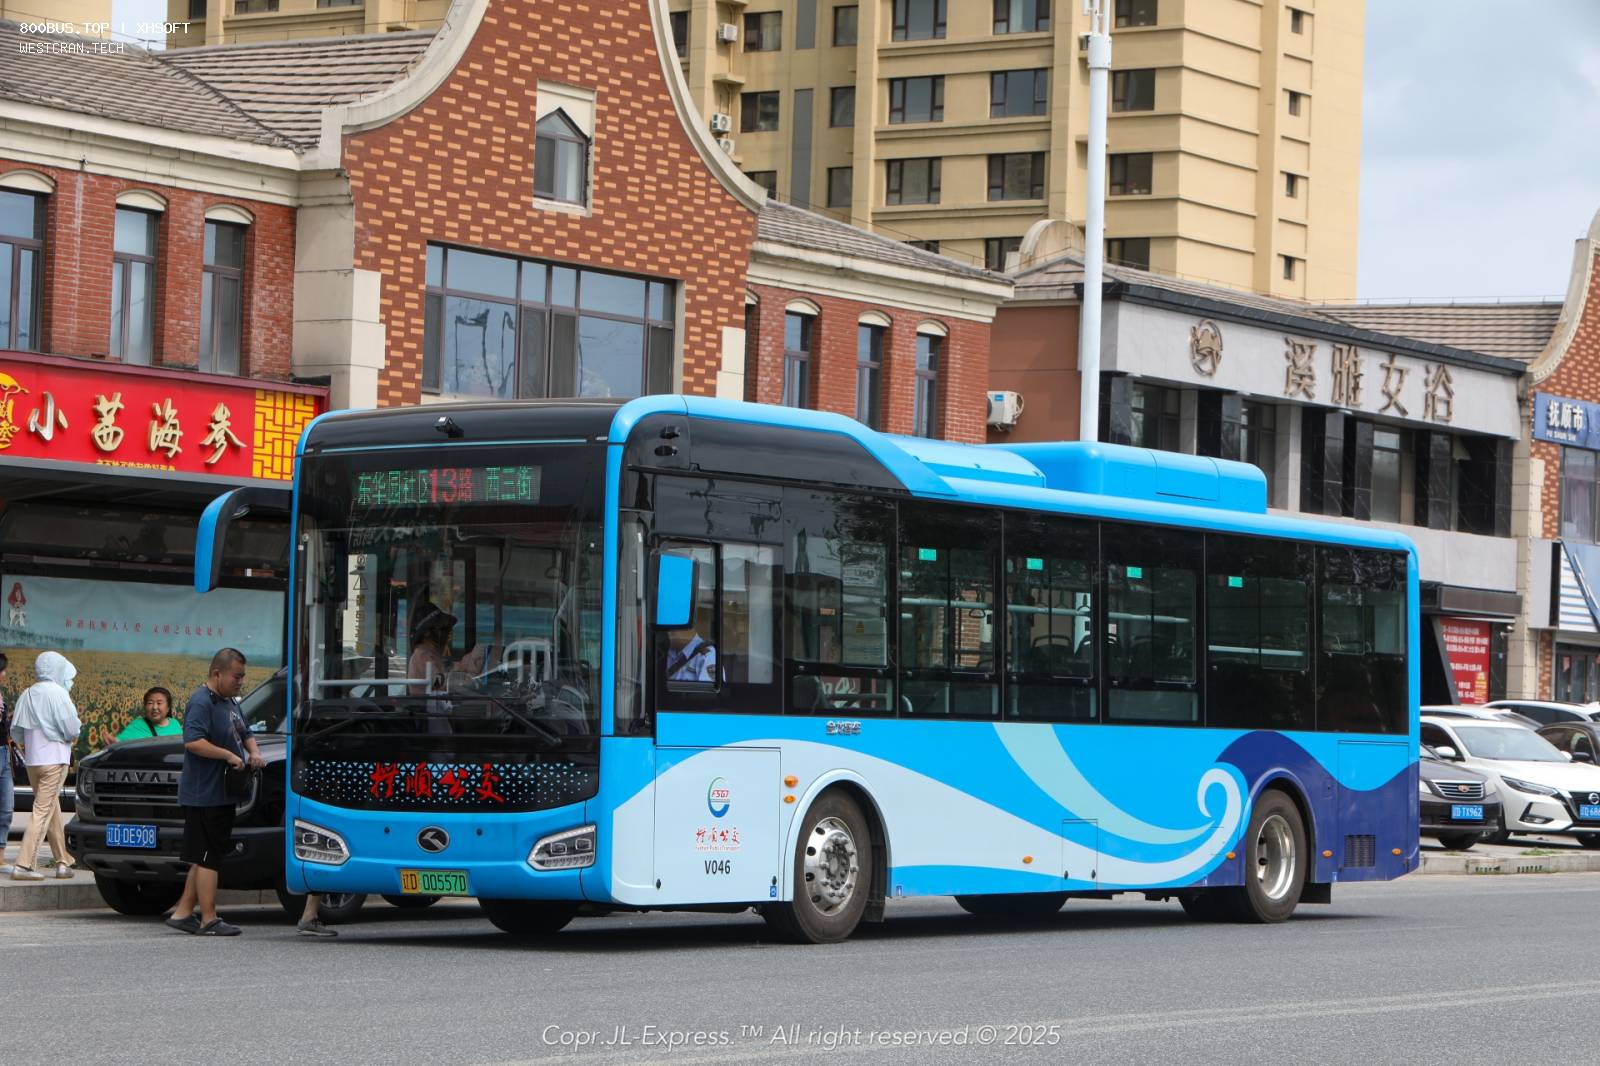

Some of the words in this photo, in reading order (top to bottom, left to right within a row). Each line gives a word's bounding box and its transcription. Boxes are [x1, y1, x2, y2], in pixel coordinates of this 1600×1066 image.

[107, 771, 177, 783] HAVAL
[369, 761, 505, 804] 抚顺公交
[704, 859, 731, 875] V046
